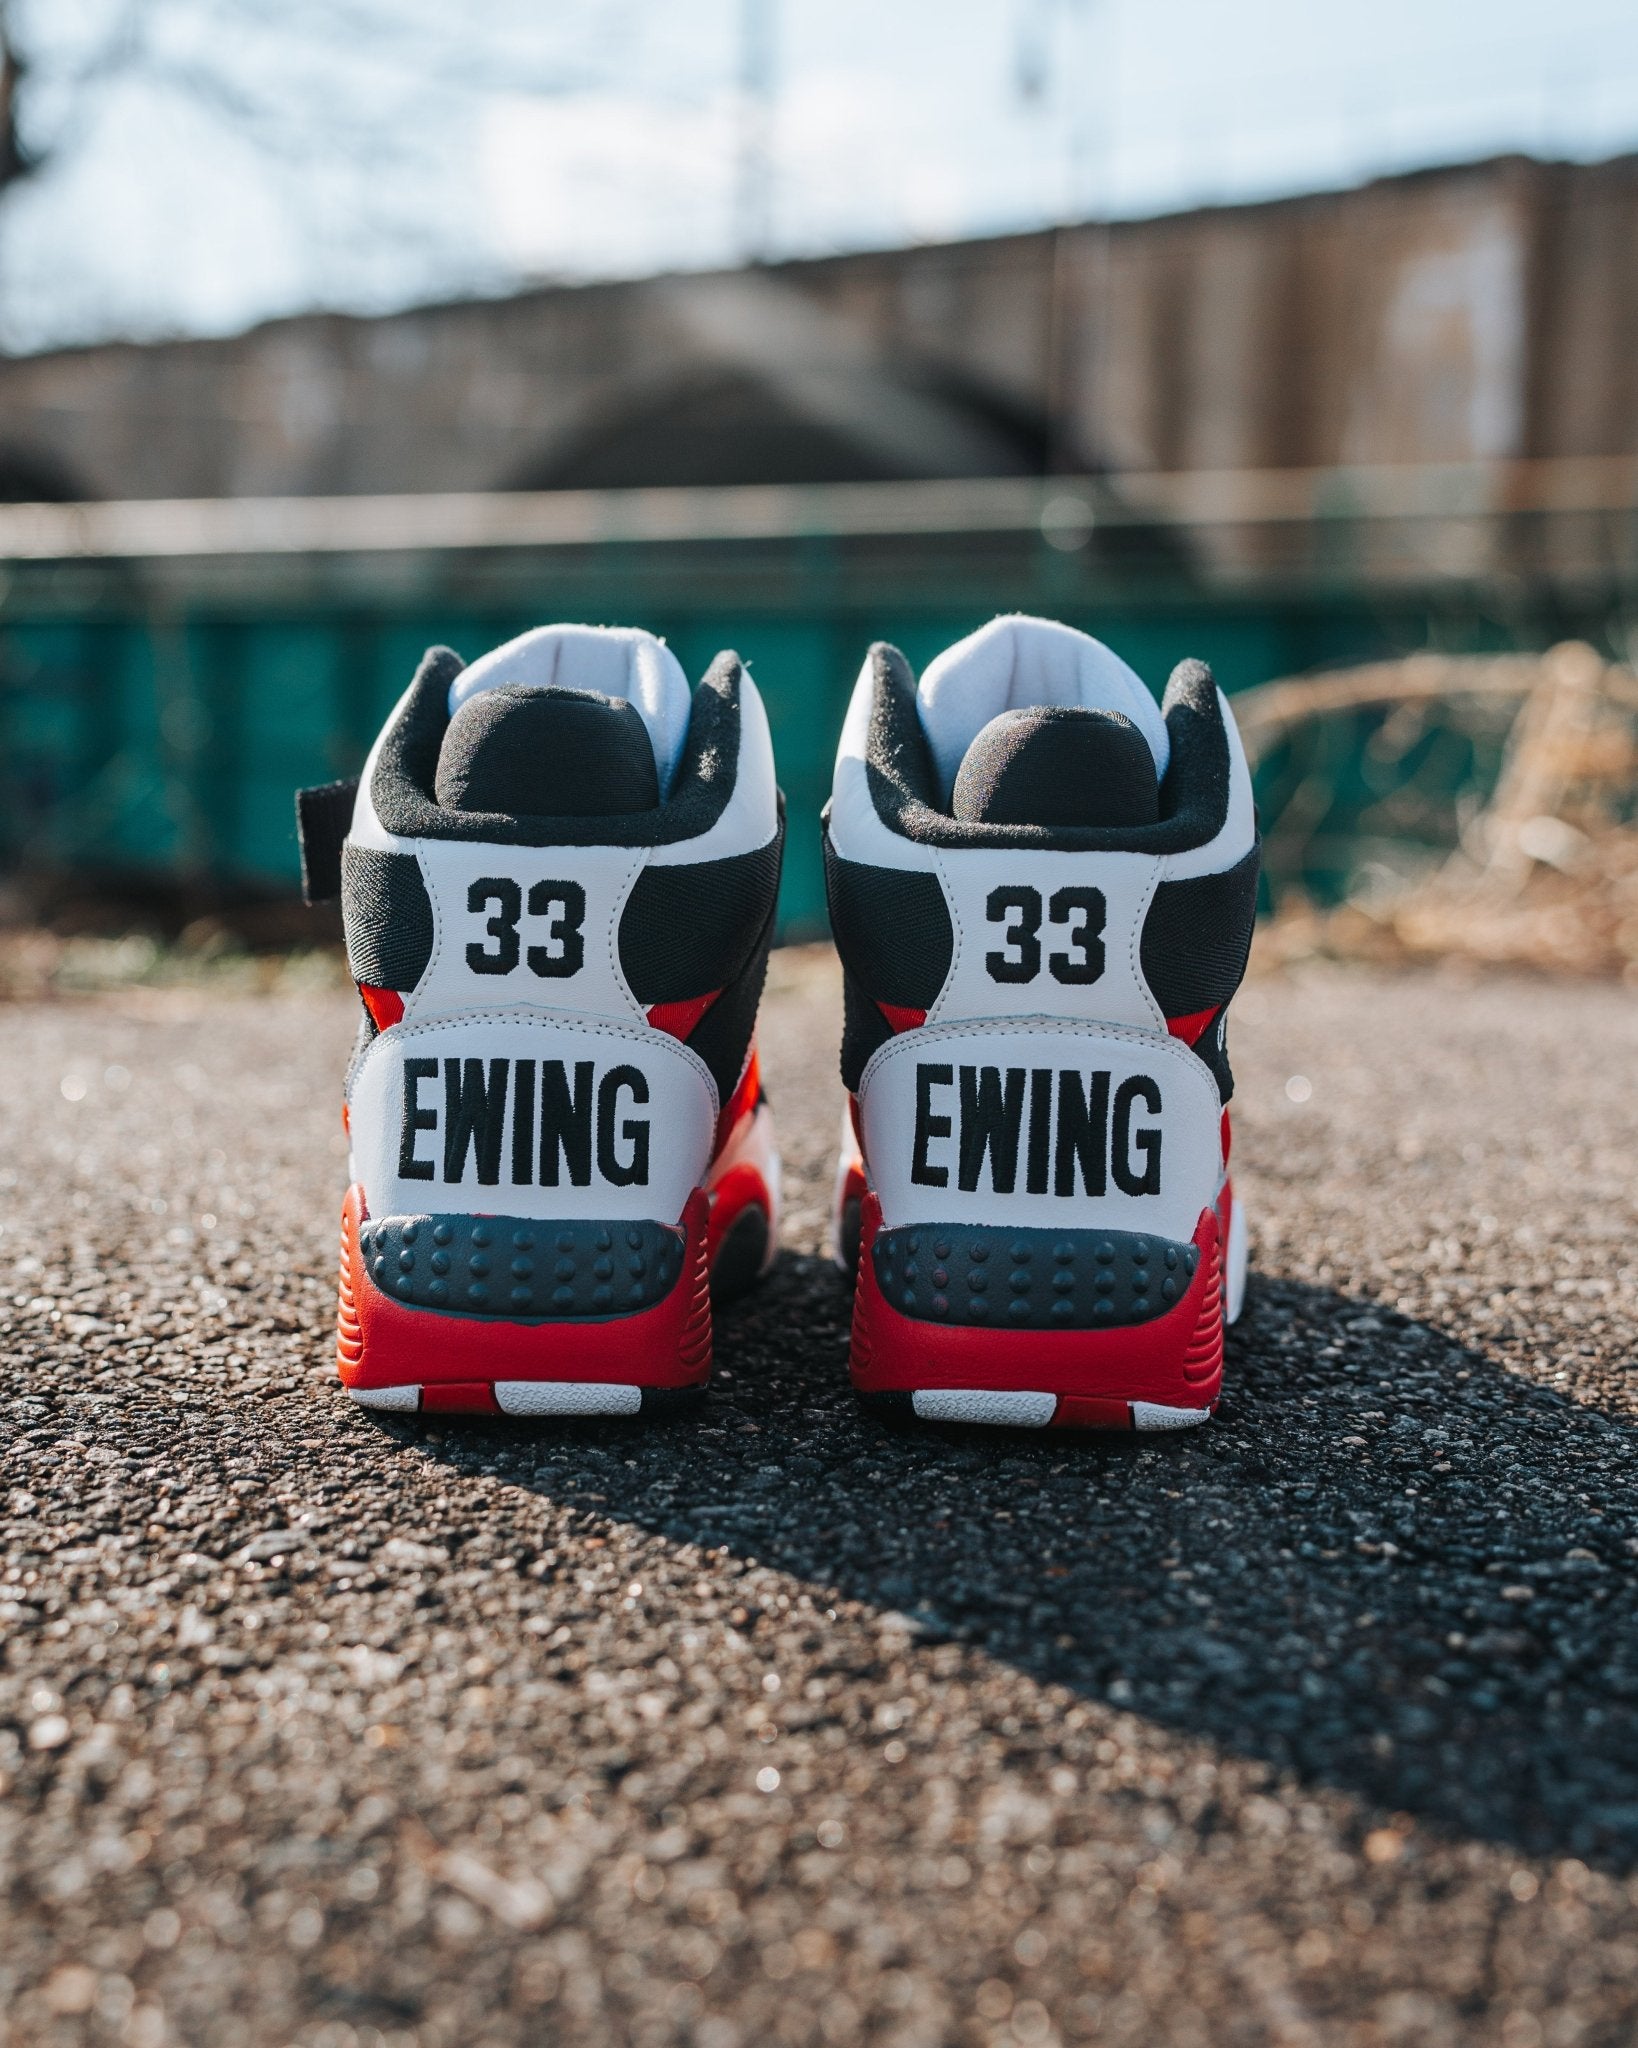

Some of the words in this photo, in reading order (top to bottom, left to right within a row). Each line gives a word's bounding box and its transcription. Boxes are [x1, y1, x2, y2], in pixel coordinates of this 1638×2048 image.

[466, 877, 586, 978] 33
[986, 886, 1106, 985] 33
[398, 1058, 650, 1187] EWING
[911, 1063, 1162, 1197] EWING
